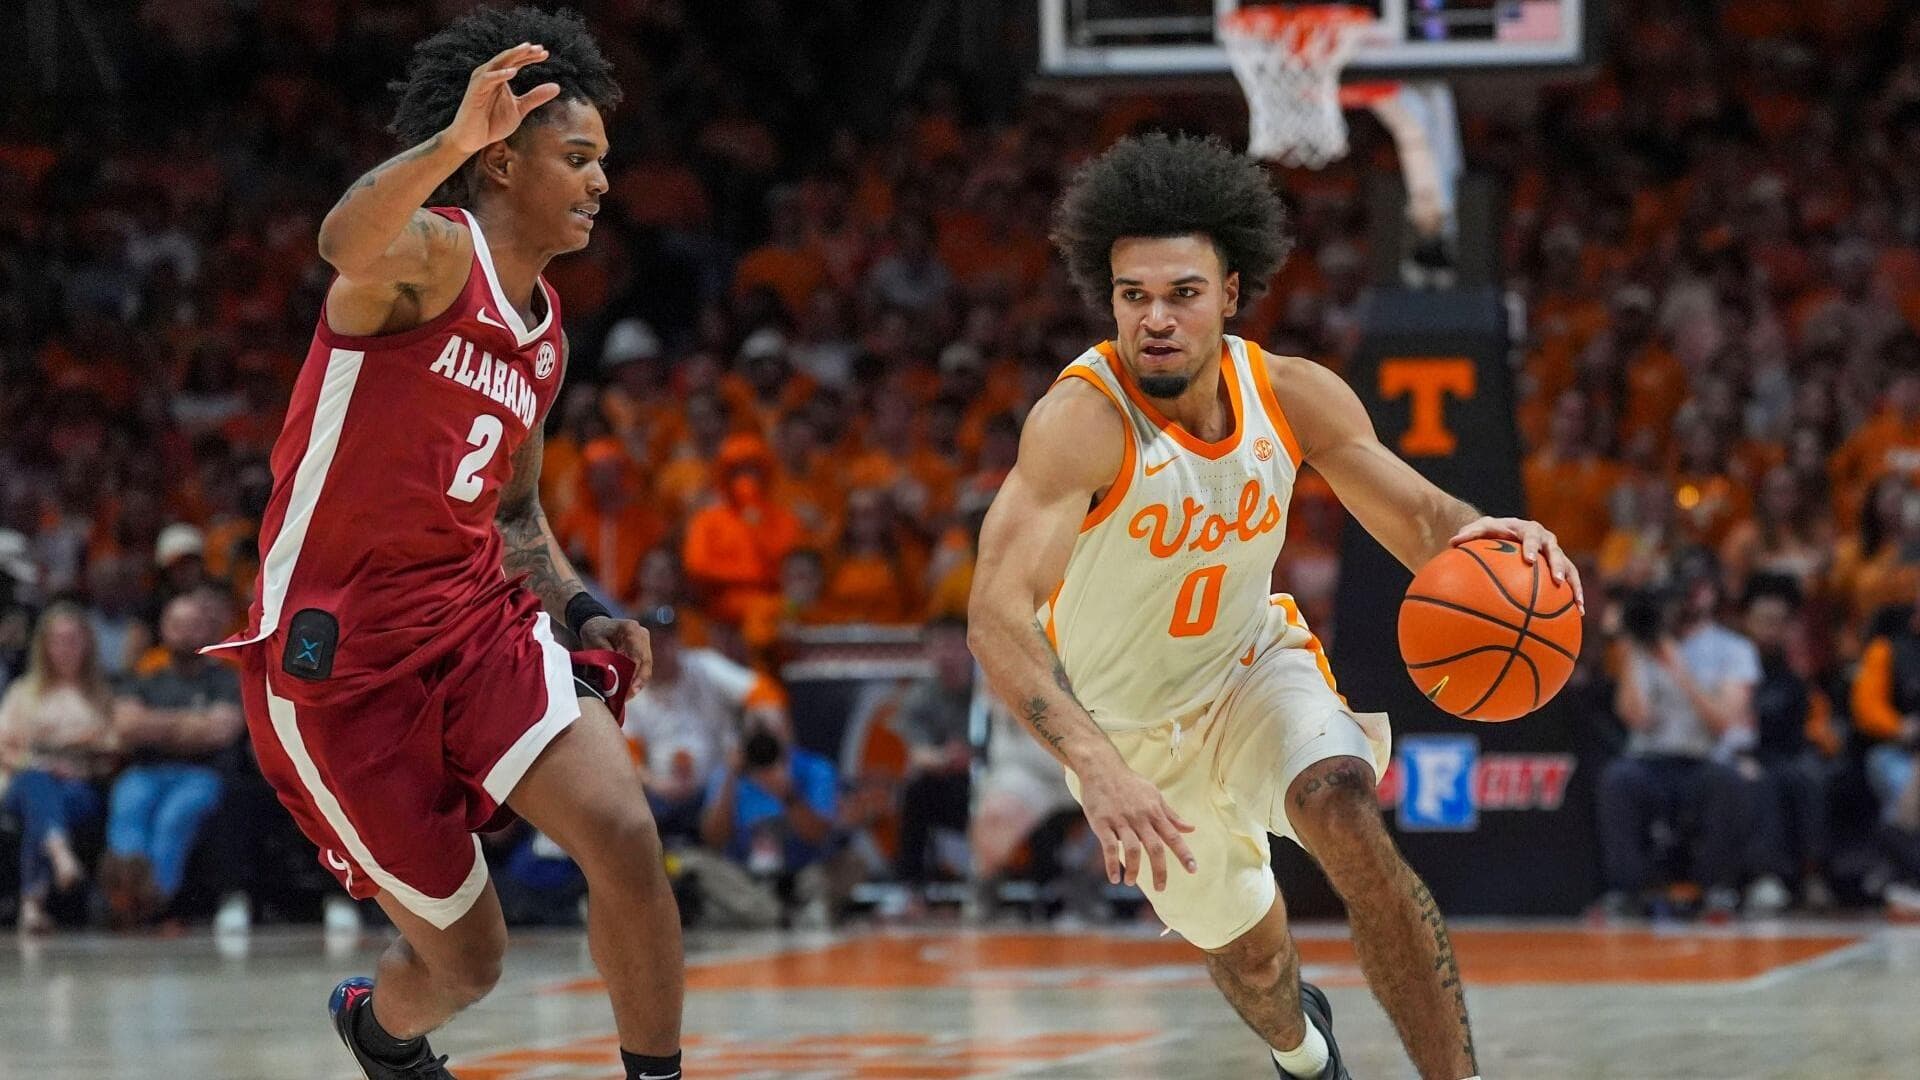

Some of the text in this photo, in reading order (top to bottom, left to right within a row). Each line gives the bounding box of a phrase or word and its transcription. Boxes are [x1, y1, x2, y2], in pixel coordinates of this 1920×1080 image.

[1379, 358, 1476, 456] T
[446, 413, 504, 503] 2
[1128, 479, 1281, 558] Vols
[1168, 563, 1228, 638] 0
